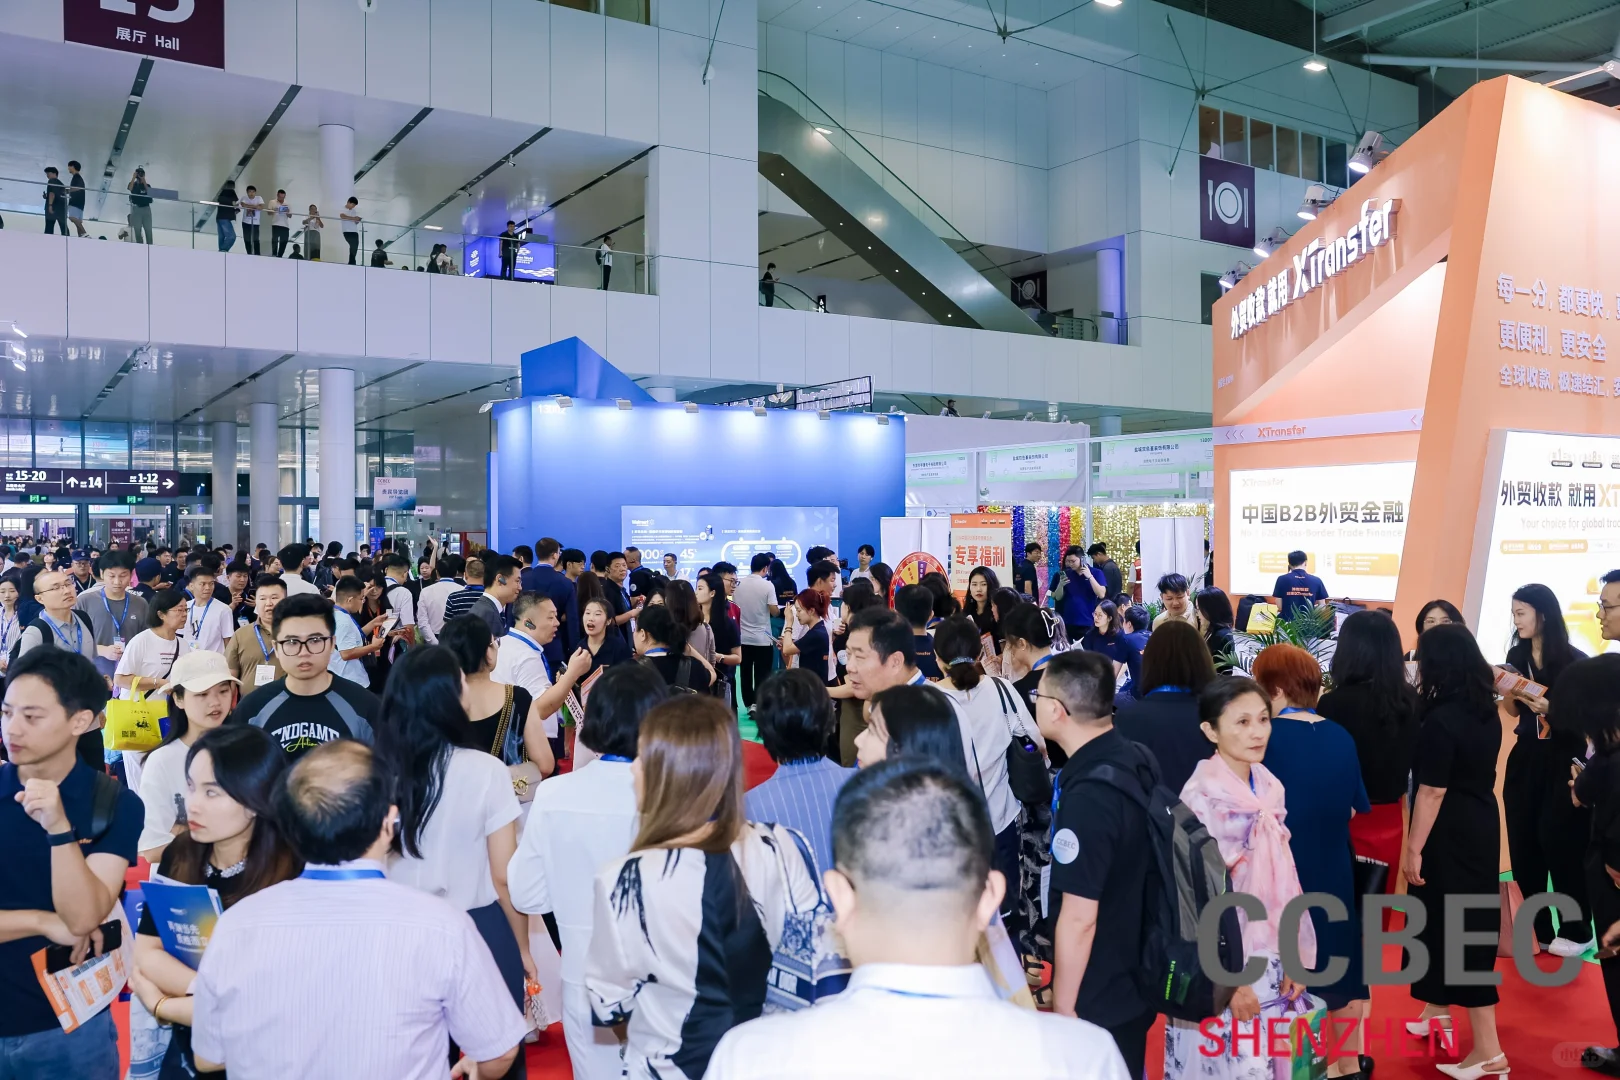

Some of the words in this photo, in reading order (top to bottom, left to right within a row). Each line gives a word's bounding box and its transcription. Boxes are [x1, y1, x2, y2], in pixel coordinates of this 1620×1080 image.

[115, 27, 147, 44] 展厅
[155, 35, 180, 51] Hall
[1230, 285, 1267, 340] 外贸收款
[1266, 268, 1292, 316] 就用
[1292, 198, 1395, 300] XTransfer
[1497, 272, 1620, 320] 每一分，都更快，
[1257, 424, 1307, 438] XTransfer
[15, 470, 47, 481] 15-20
[88, 476, 103, 489] 14
[138, 473, 159, 483] 1-12
[1501, 480, 1563, 507] 外贸收款
[1242, 501, 1404, 525] 中国B2B外贸金融
[1521, 517, 1540, 529] Your
[1541, 517, 1567, 529] choice
[1568, 517, 1580, 529] for
[1582, 518, 1605, 531] global
[1338, 528, 1364, 538] Trade
[1366, 528, 1404, 539] Finance
[955, 545, 1006, 567] 专享福利
